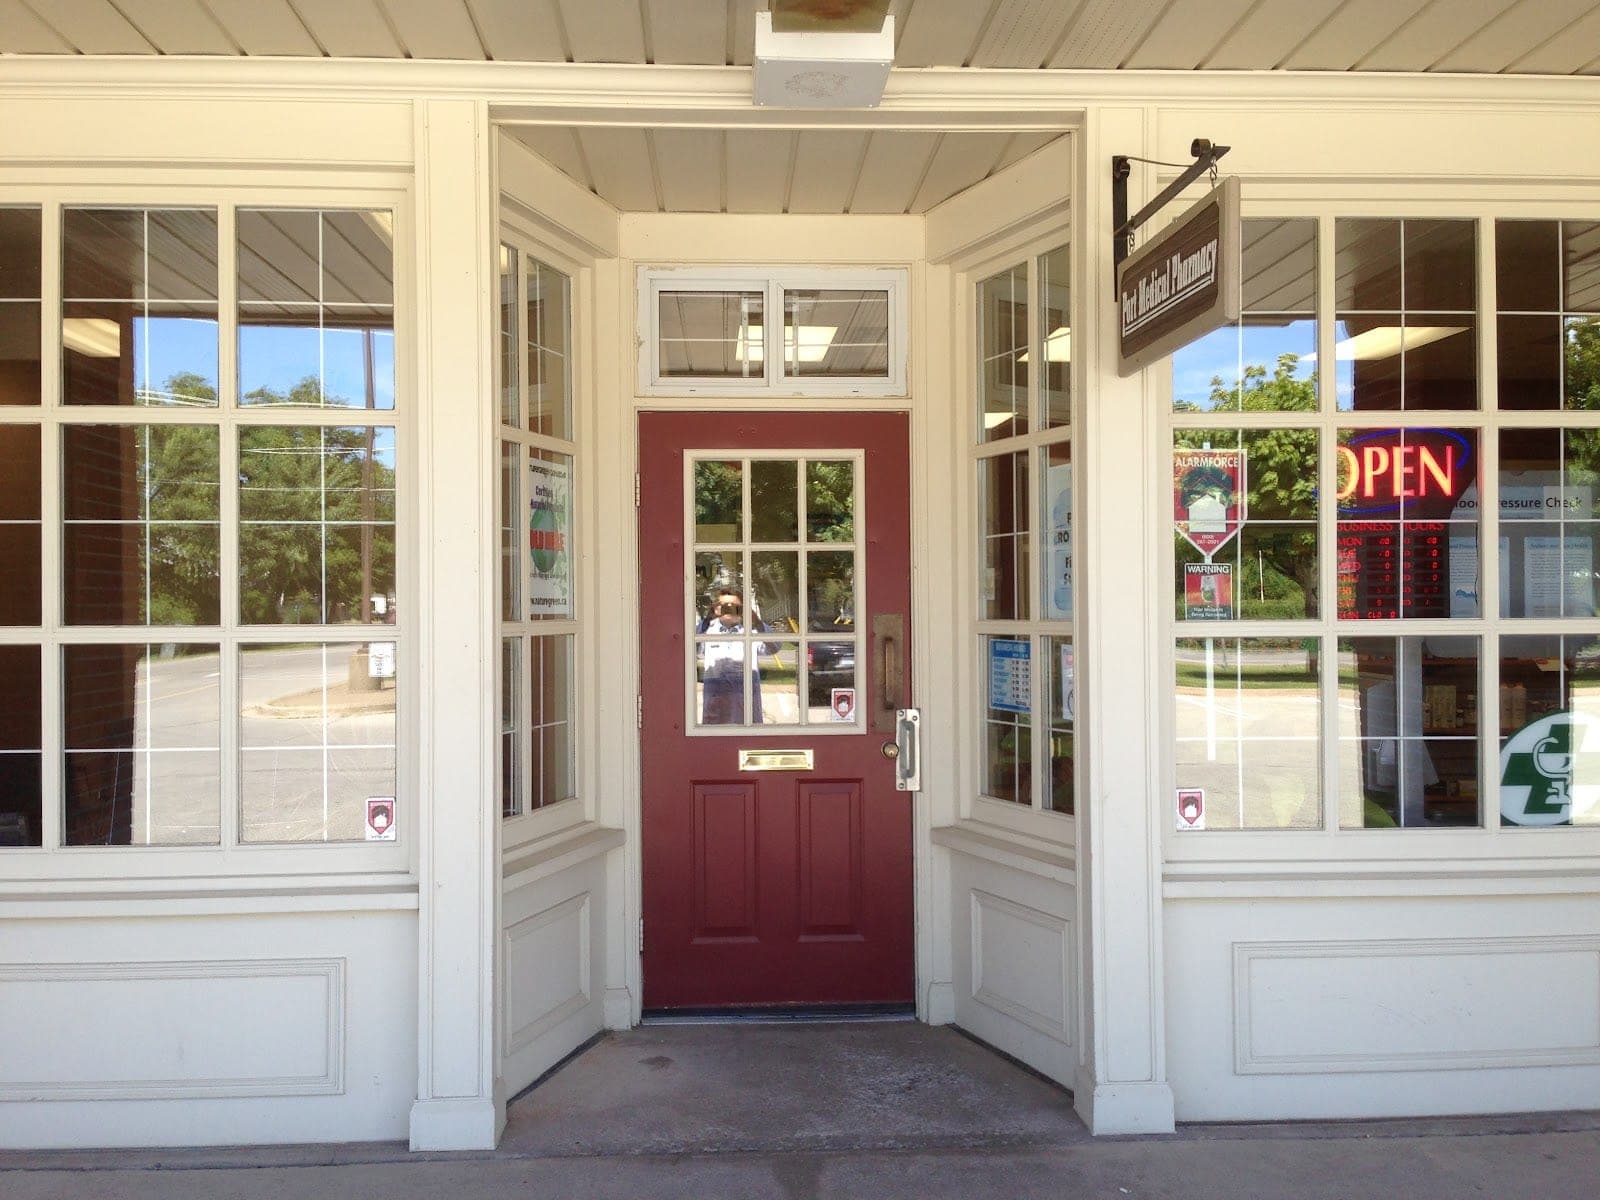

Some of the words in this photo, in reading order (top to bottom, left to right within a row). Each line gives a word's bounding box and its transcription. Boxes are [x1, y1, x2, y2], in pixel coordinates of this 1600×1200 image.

[1122, 288, 1137, 337] Port
[1139, 258, 1170, 315] Medical
[1171, 238, 1218, 295] Pharmacy
[1175, 456, 1239, 468] ALARMFORCE
[1187, 565, 1229, 574] WARNING
